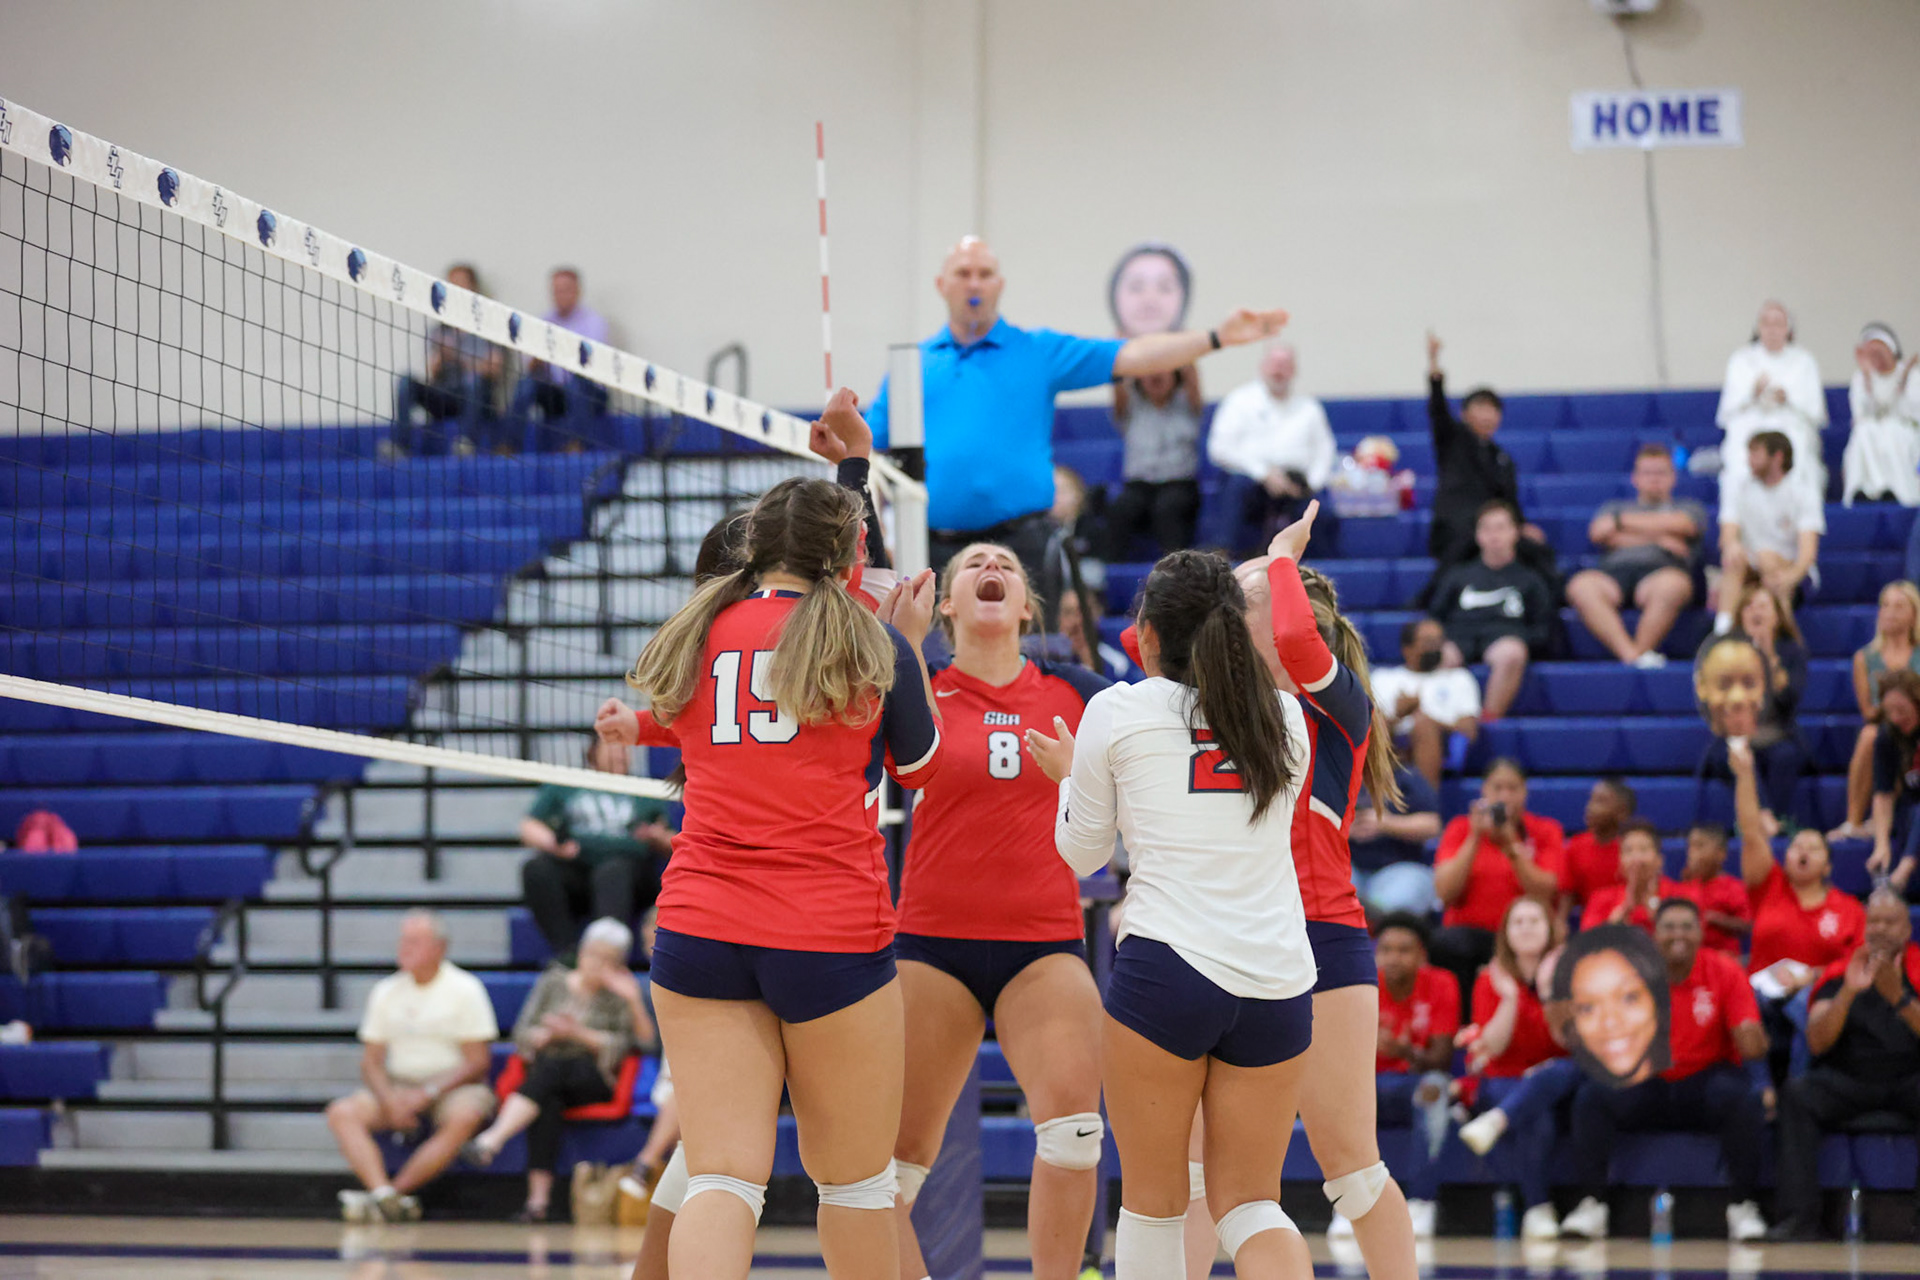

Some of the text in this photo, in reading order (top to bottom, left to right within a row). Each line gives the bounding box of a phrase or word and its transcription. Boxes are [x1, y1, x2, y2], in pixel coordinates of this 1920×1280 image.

[1593, 97, 1720, 136] HOME
[711, 650, 800, 745] 15
[983, 711, 1021, 726] SBA
[988, 731, 1022, 780] 8
